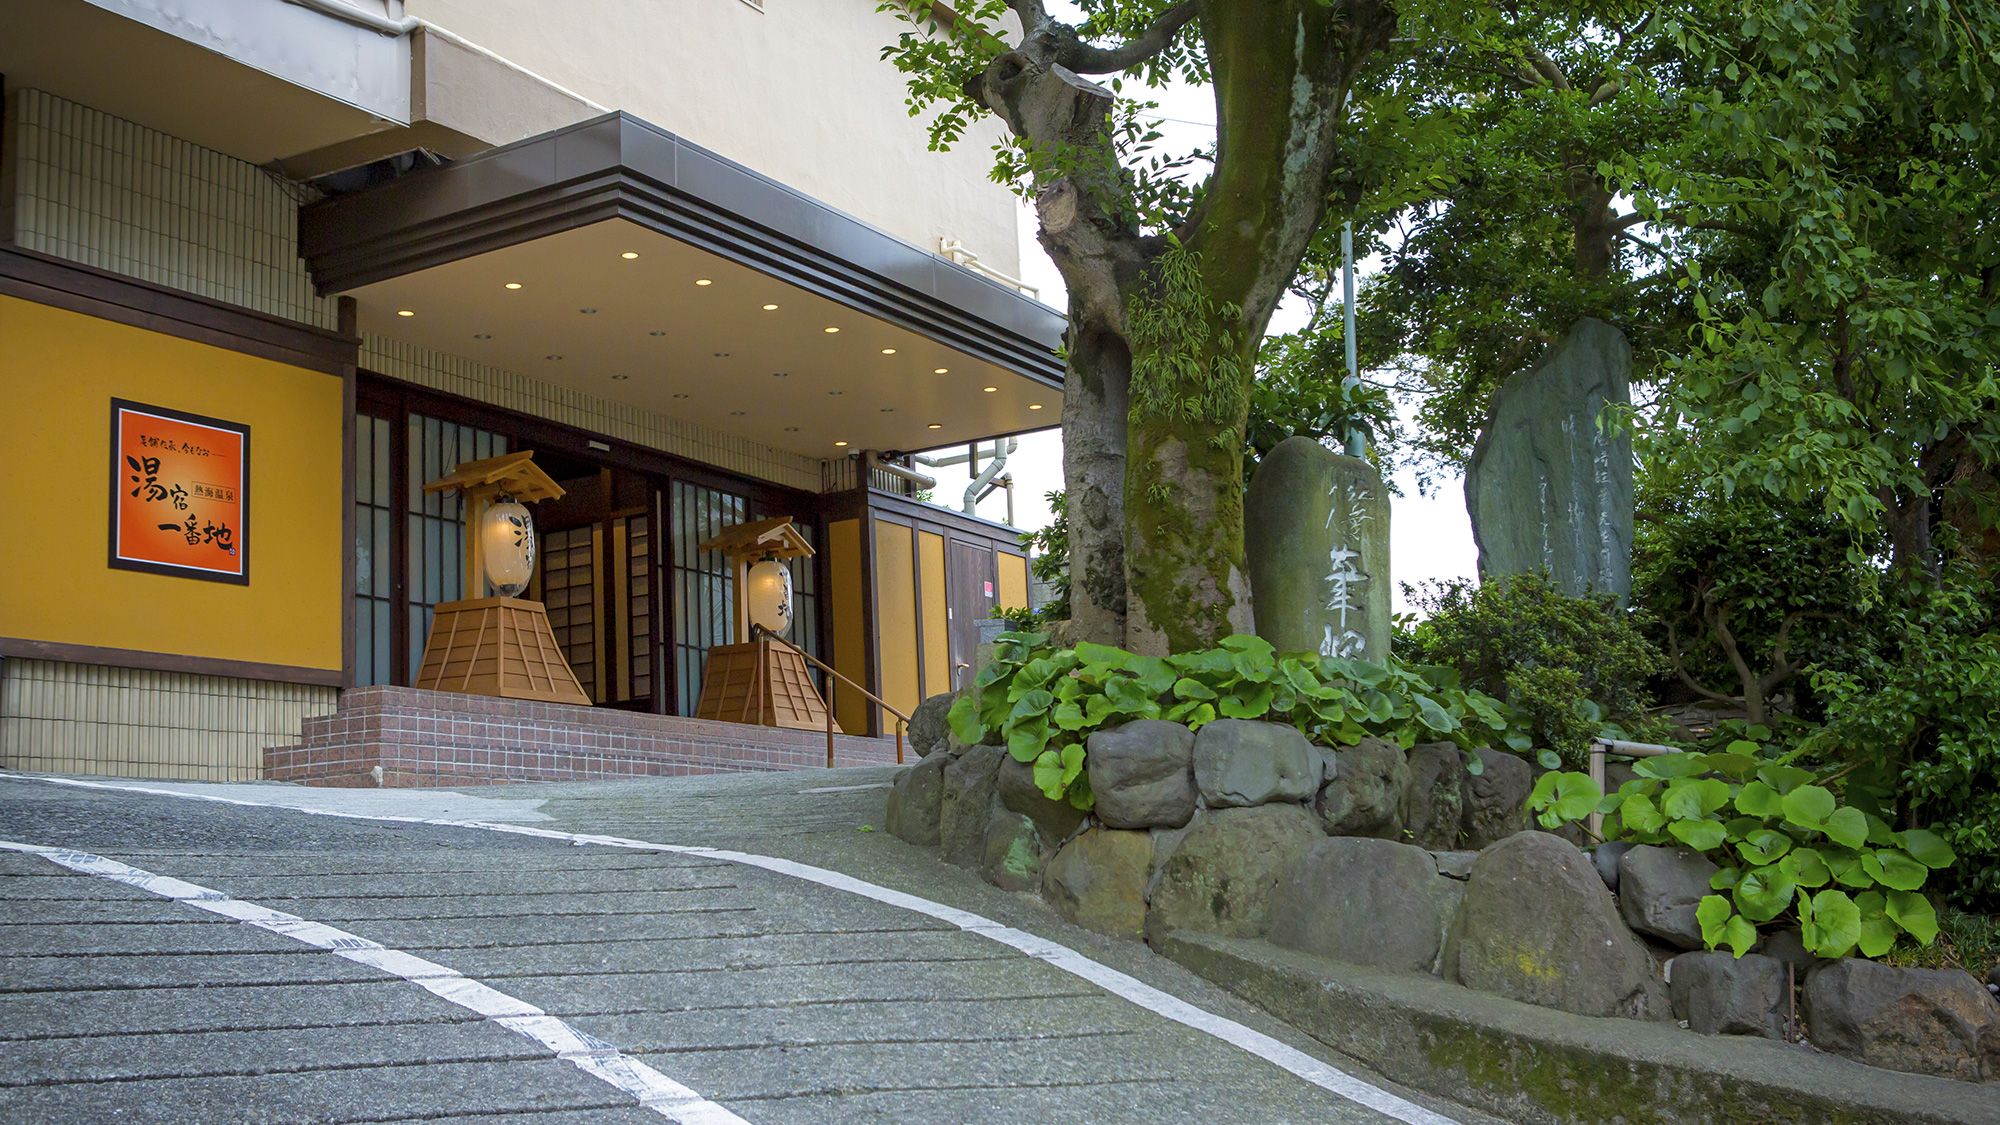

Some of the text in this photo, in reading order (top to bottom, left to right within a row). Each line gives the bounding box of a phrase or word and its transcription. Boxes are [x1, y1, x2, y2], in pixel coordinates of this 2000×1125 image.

[194, 484, 234, 501] 熱海温泉
[157, 513, 233, 551] 一番地
